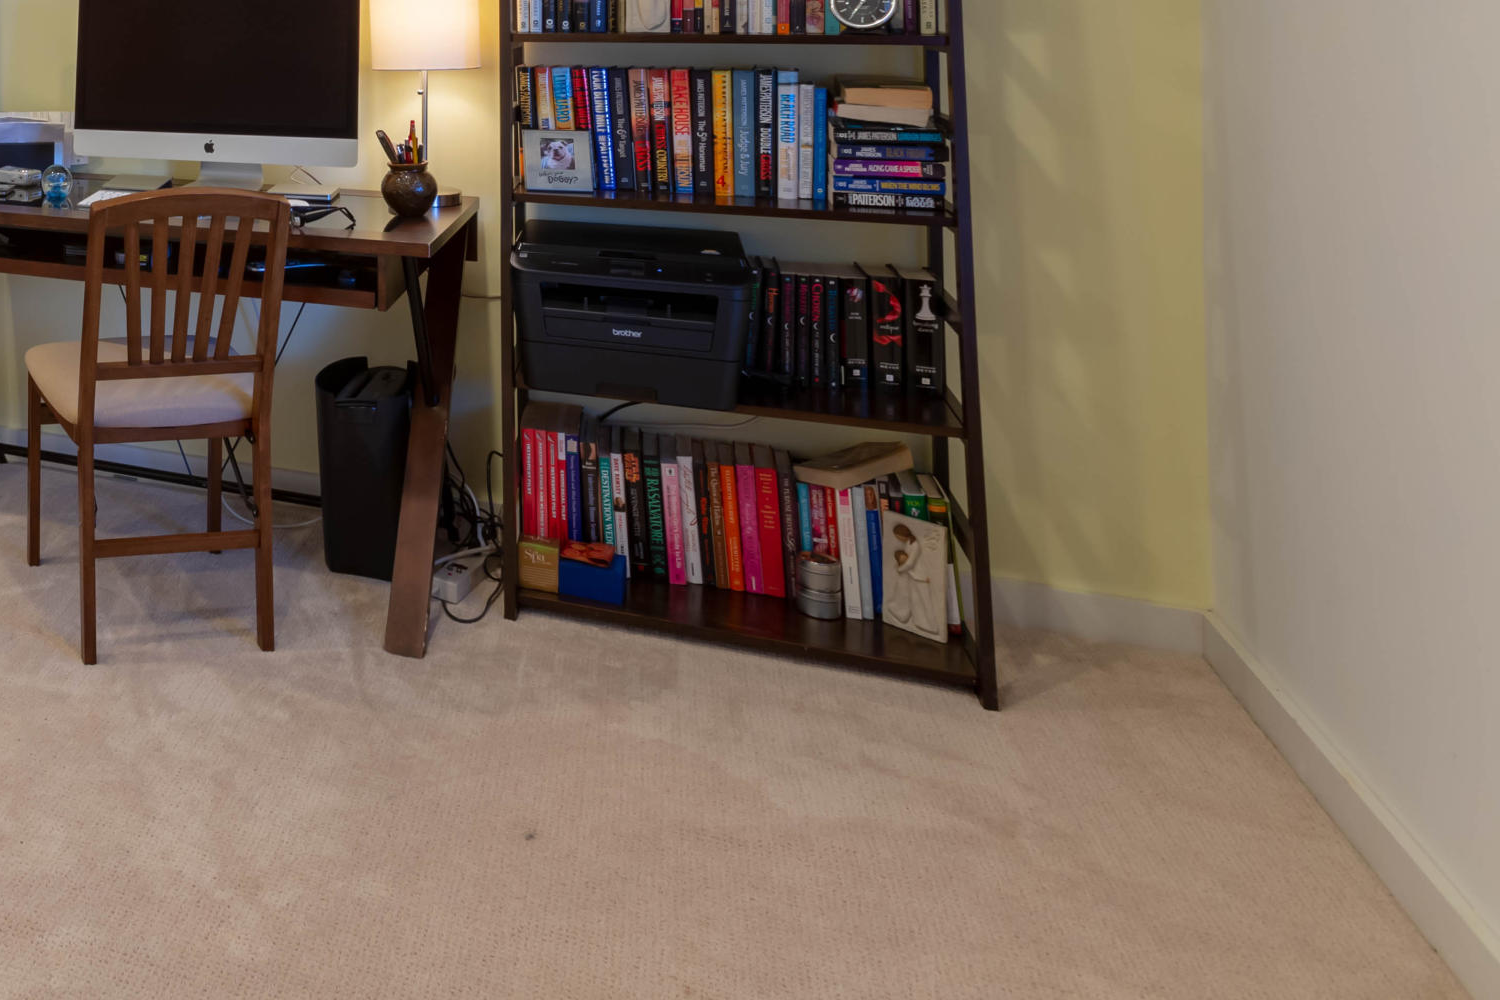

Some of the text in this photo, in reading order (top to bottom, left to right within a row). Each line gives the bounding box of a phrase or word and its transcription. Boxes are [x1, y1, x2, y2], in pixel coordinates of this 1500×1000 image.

[520, 71, 530, 125] JAMES PATTERSON
[591, 70, 610, 132] FOUR BLIND MICE
[652, 77, 665, 121] JAMES PATTERSON
[697, 78, 705, 117] JAMES PATTERSON
[760, 74, 772, 124] JAMES PATTERSON
[617, 118, 625, 128] The
[675, 108, 690, 136] HOUSE
[698, 121, 706, 131] The
[780, 94, 796, 143] BEACH ROAD
[618, 140, 627, 158] Target
[697, 132, 707, 142] 5th
[738, 130, 750, 153] Judge
[635, 140, 652, 171] CROSS
[656, 150, 668, 182] COUNTRY
[738, 160, 750, 176] Jury
[760, 128, 771, 180] DOUBLE CROSS
[868, 164, 884, 172] ALONG
[852, 194, 895, 206] PATTERSON
[812, 283, 824, 322] CHOSEN
[612, 328, 642, 338] brother
[600, 469, 610, 521] DESTINATION
[648, 492, 664, 544] SALVATORE
[524, 549, 546, 564] Spa
